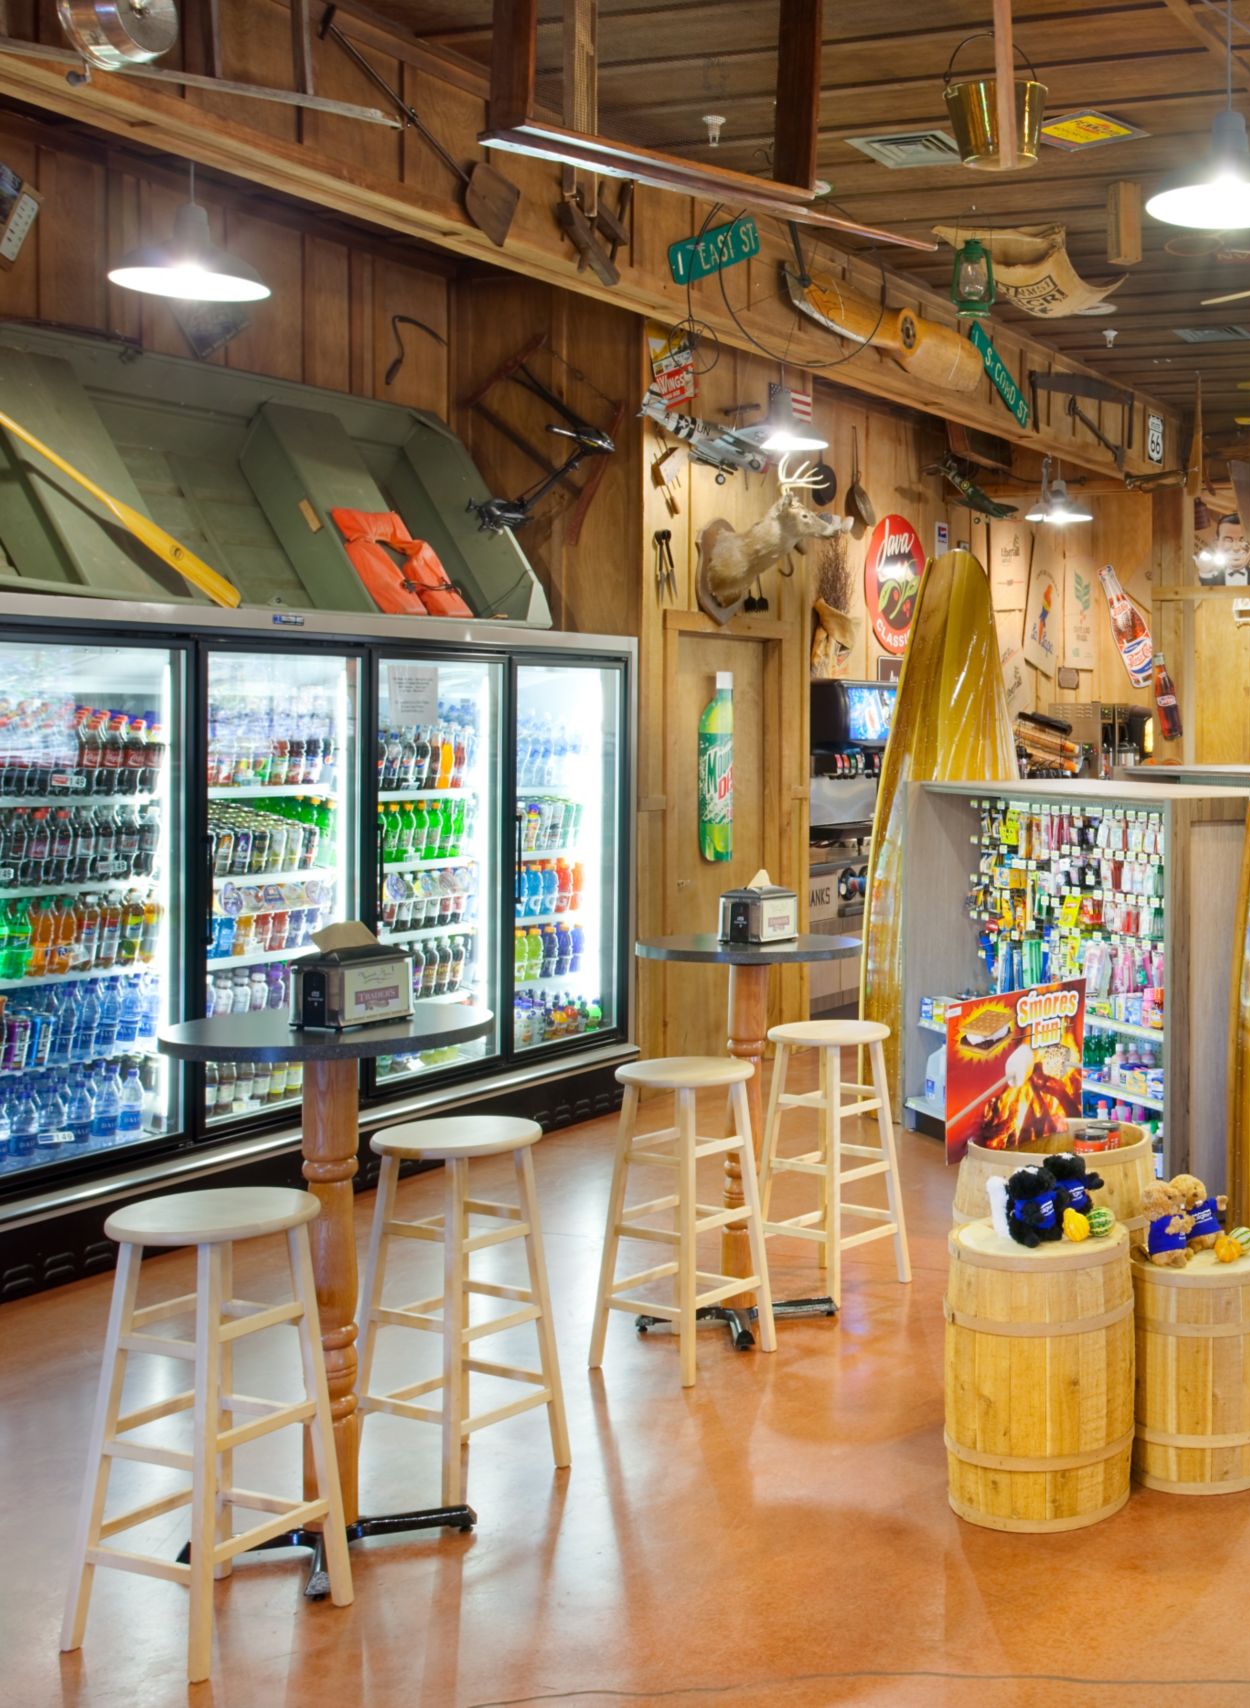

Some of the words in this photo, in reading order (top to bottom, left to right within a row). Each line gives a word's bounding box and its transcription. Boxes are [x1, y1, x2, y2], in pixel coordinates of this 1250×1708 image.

[699, 230, 735, 271] EAST
[739, 222, 757, 254] ST
[1016, 402, 1029, 424] ST
[1151, 433, 1161, 455] 66
[876, 518, 915, 572] Java
[809, 887, 831, 908] ANKS
[1031, 1018, 1061, 1049] Fun
